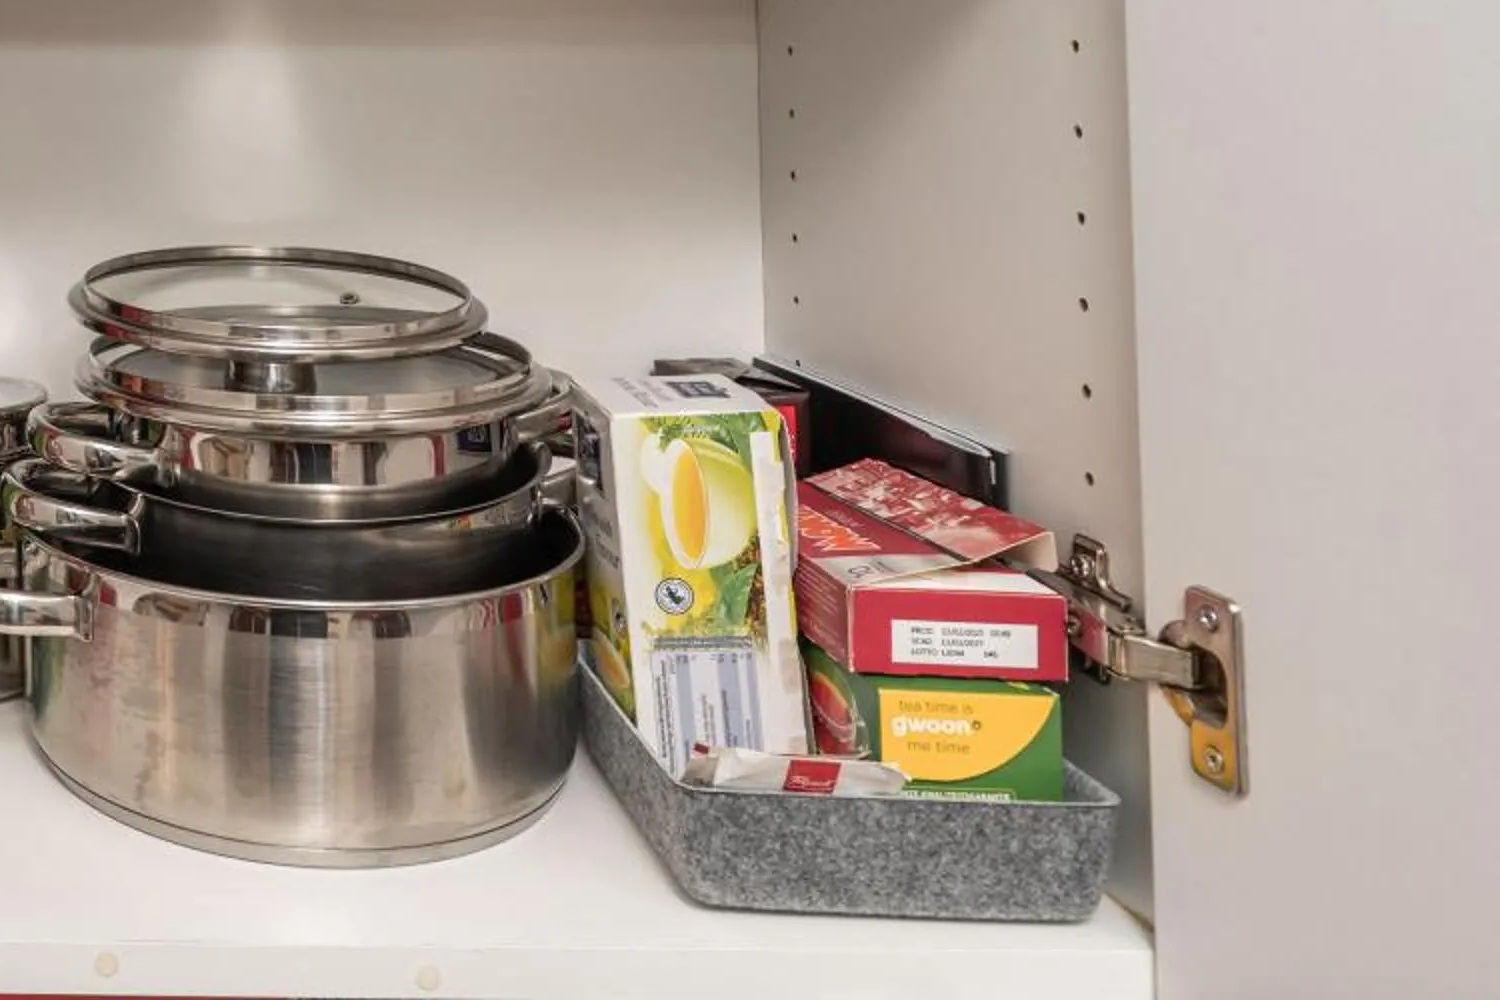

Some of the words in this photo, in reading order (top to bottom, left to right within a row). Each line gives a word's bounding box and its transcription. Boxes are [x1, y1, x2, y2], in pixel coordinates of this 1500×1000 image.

[898, 699, 922, 713] tea
[925, 700, 959, 714] time
[961, 702, 974, 714] is
[891, 716, 972, 737] gwoon
[907, 741, 931, 752] me
[934, 738, 971, 754] time
